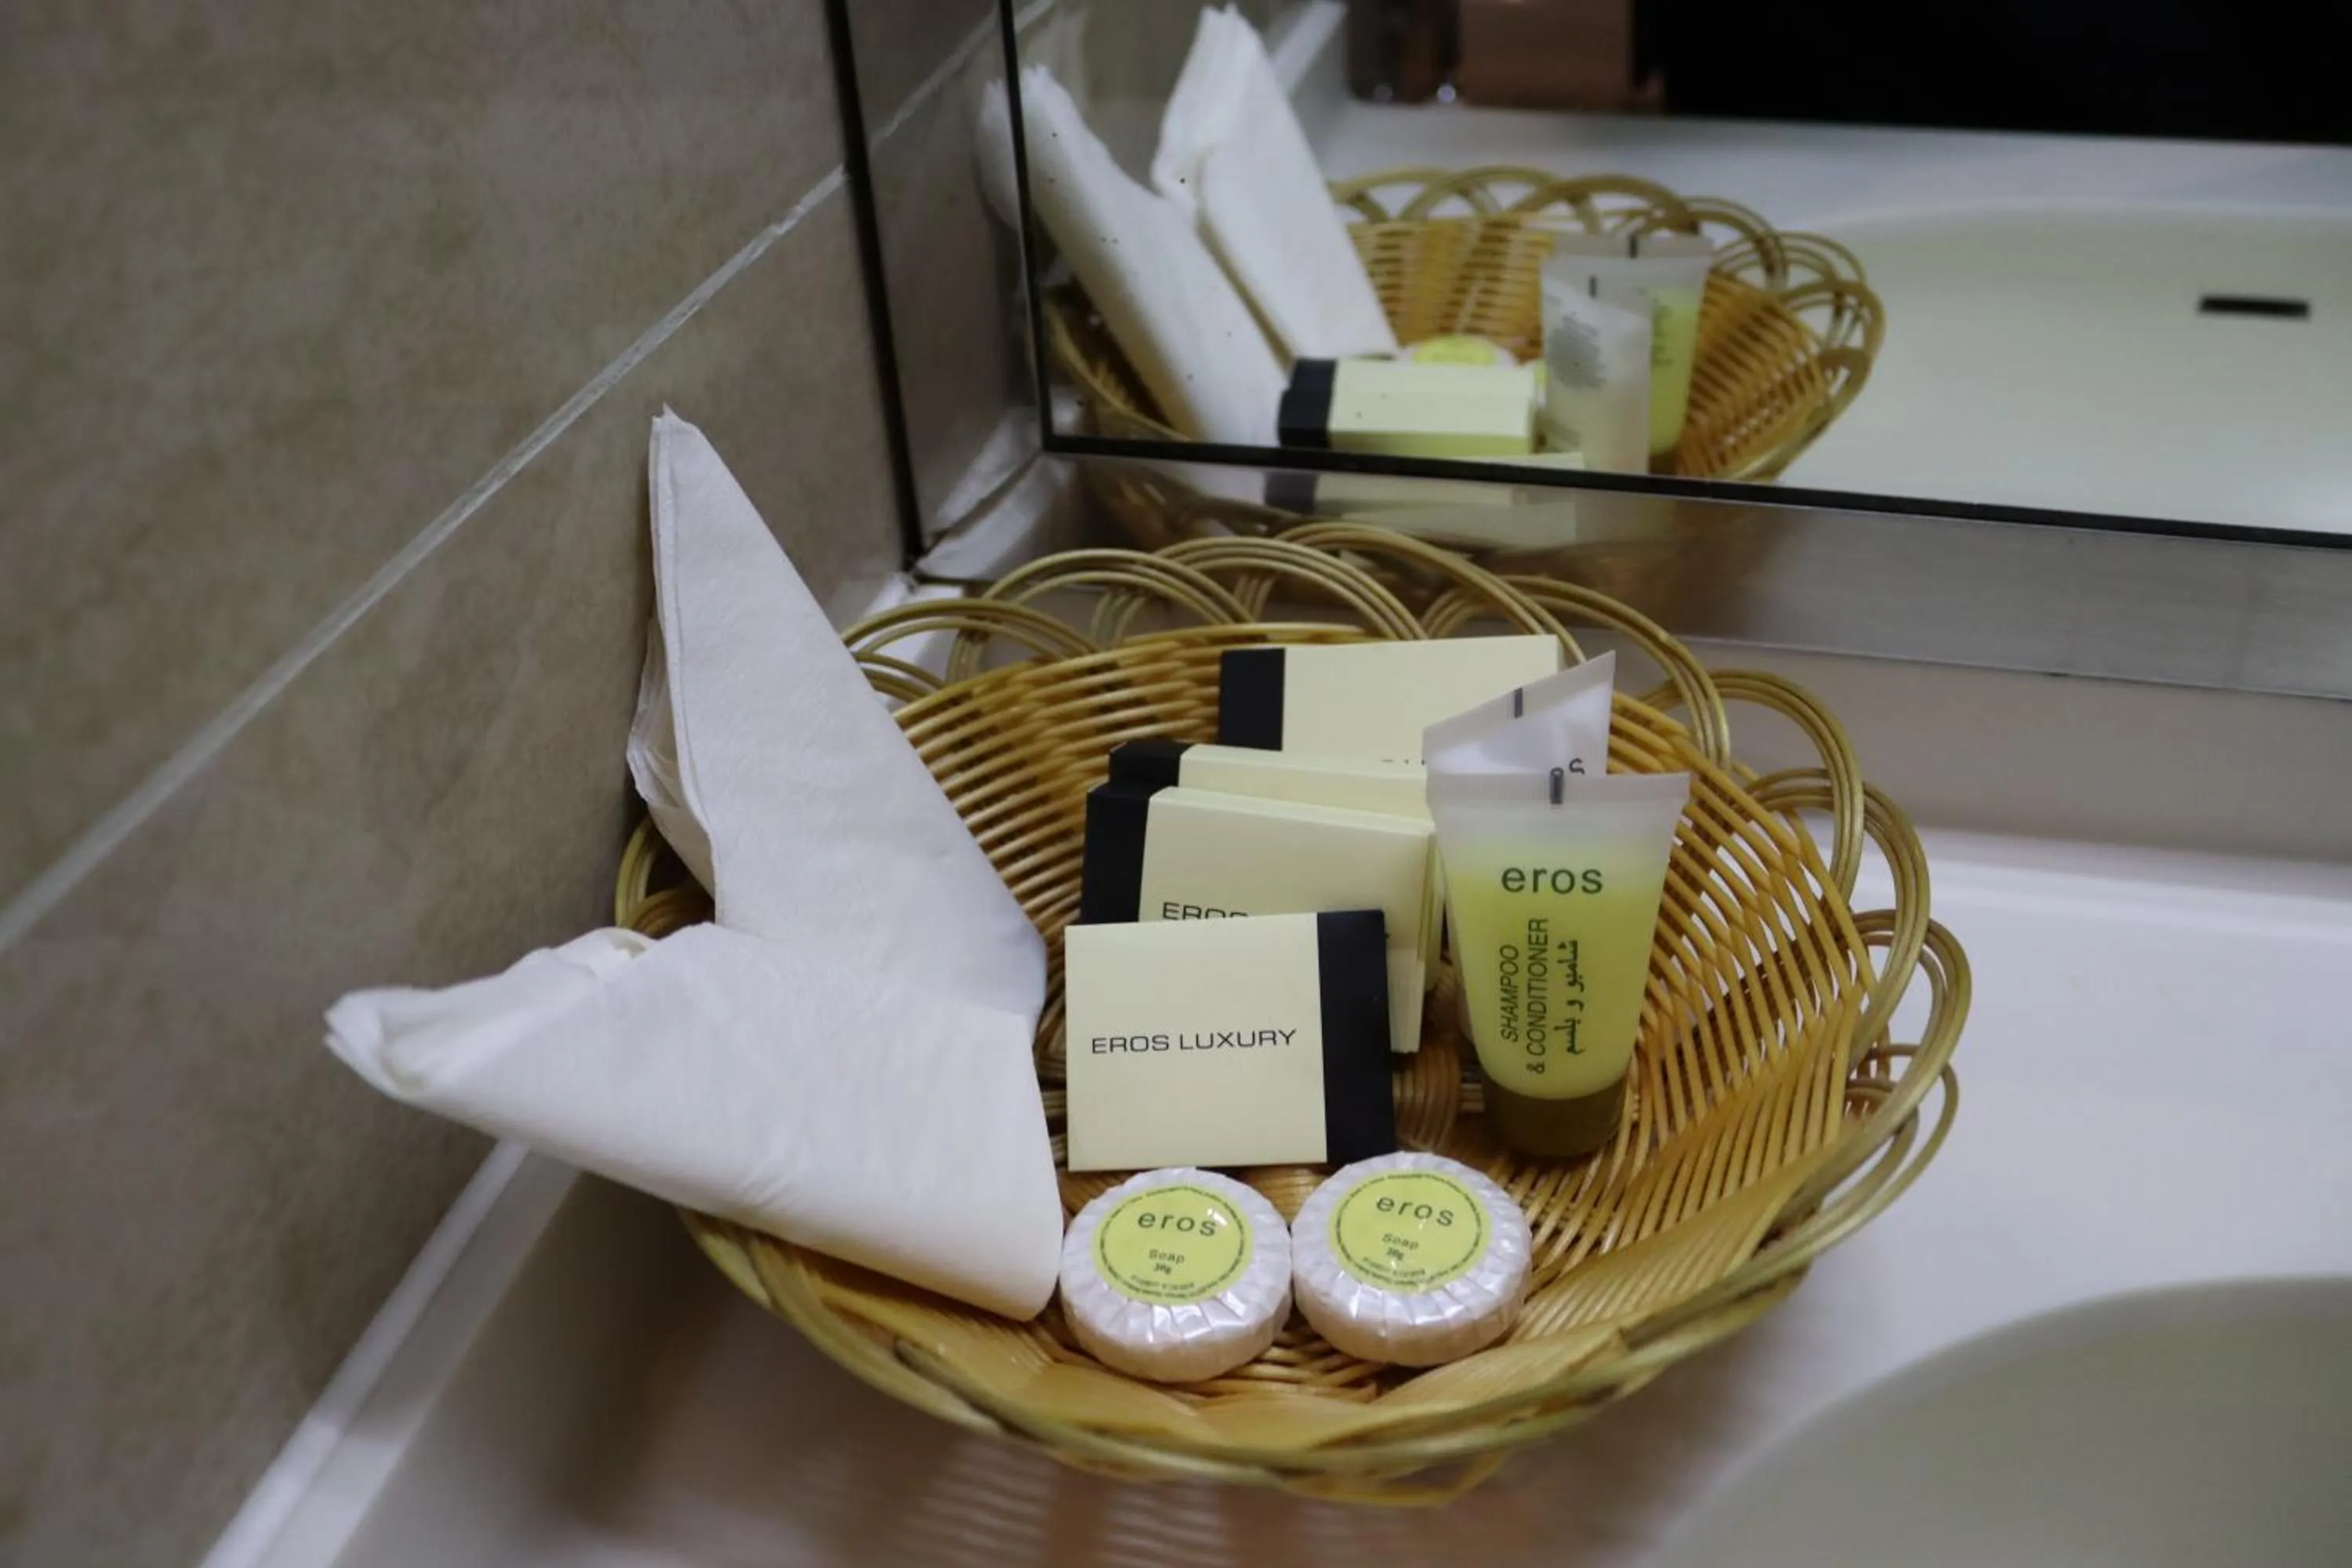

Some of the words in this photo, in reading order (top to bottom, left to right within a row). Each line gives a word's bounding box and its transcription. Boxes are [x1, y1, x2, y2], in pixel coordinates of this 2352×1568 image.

[1501, 866, 1603, 895] eros
[1162, 902, 1249, 920] ERO
[1499, 944, 1519, 1043] SHAMPOO
[1526, 917, 1549, 1057] CONDITIONER
[1091, 1034, 1170, 1054] EROS
[1179, 1028, 1297, 1051] LUXURY
[1526, 1062, 1546, 1075] &
[1376, 1196, 1454, 1227] eros
[1137, 1212, 1218, 1237] eros
[1381, 1233, 1419, 1250] Soap
[1149, 1248, 1185, 1265] Soap
